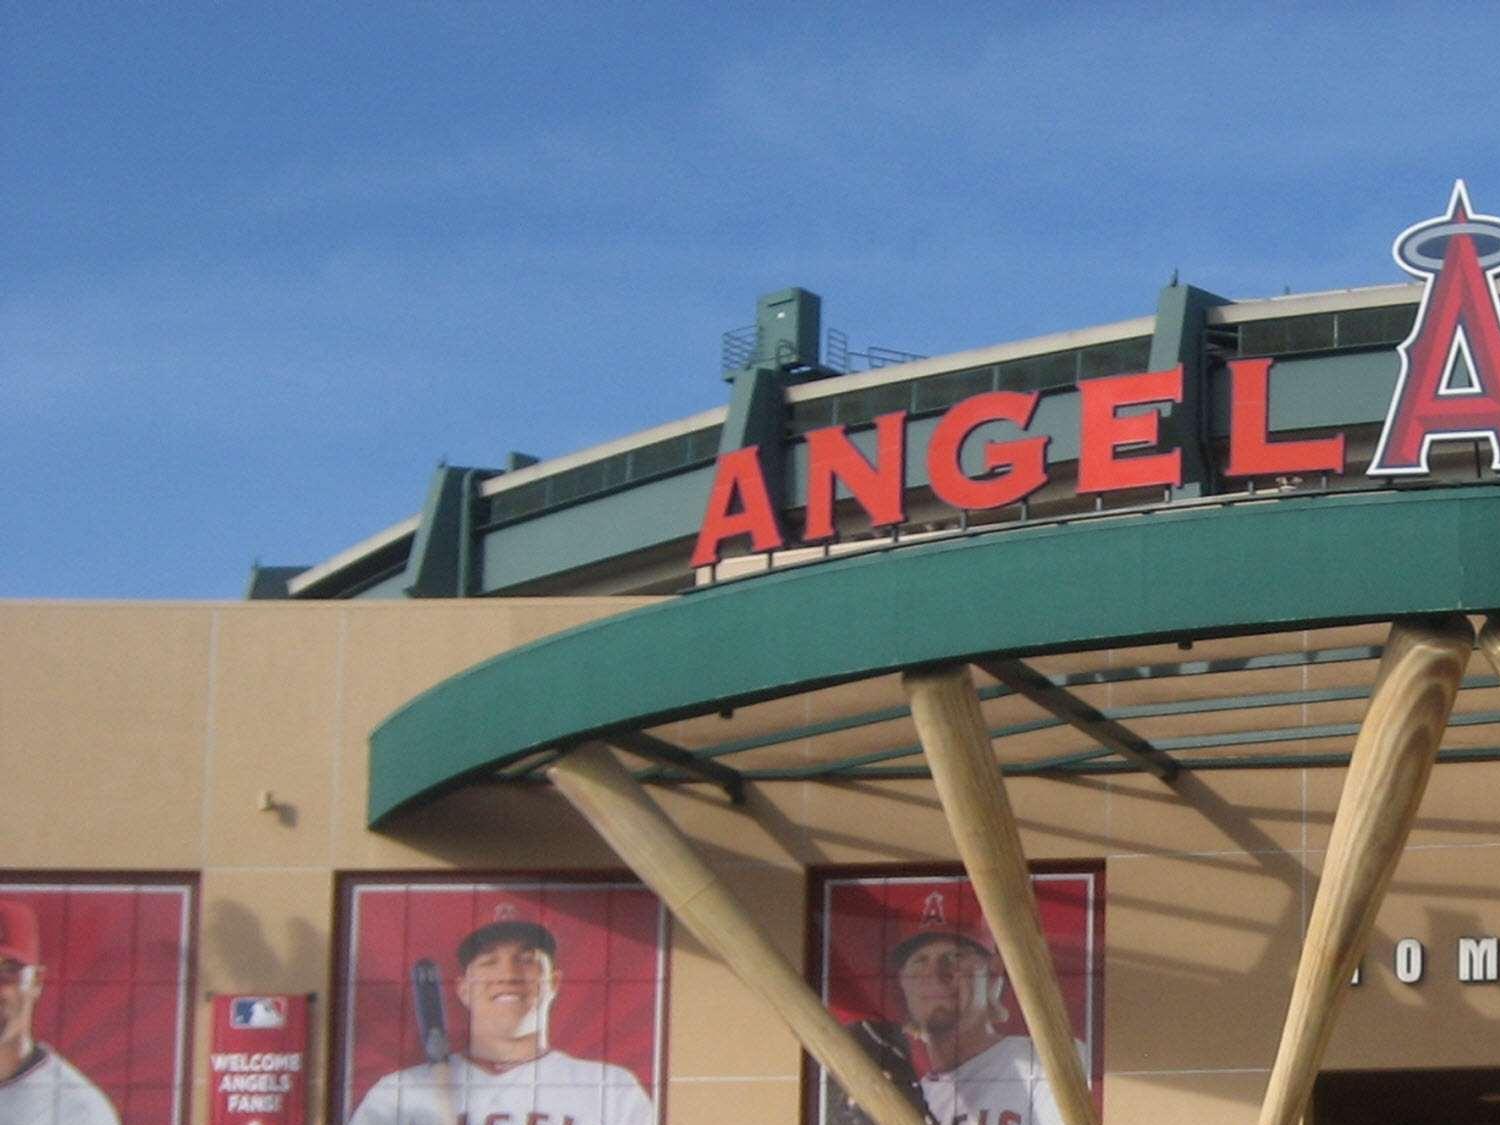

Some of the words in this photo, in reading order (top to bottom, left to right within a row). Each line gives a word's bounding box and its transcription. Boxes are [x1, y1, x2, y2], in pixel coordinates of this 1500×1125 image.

[690, 358, 1346, 568] ANGEL
[210, 1053, 302, 1072] WELCOME
[219, 1073, 290, 1093] ANGELS
